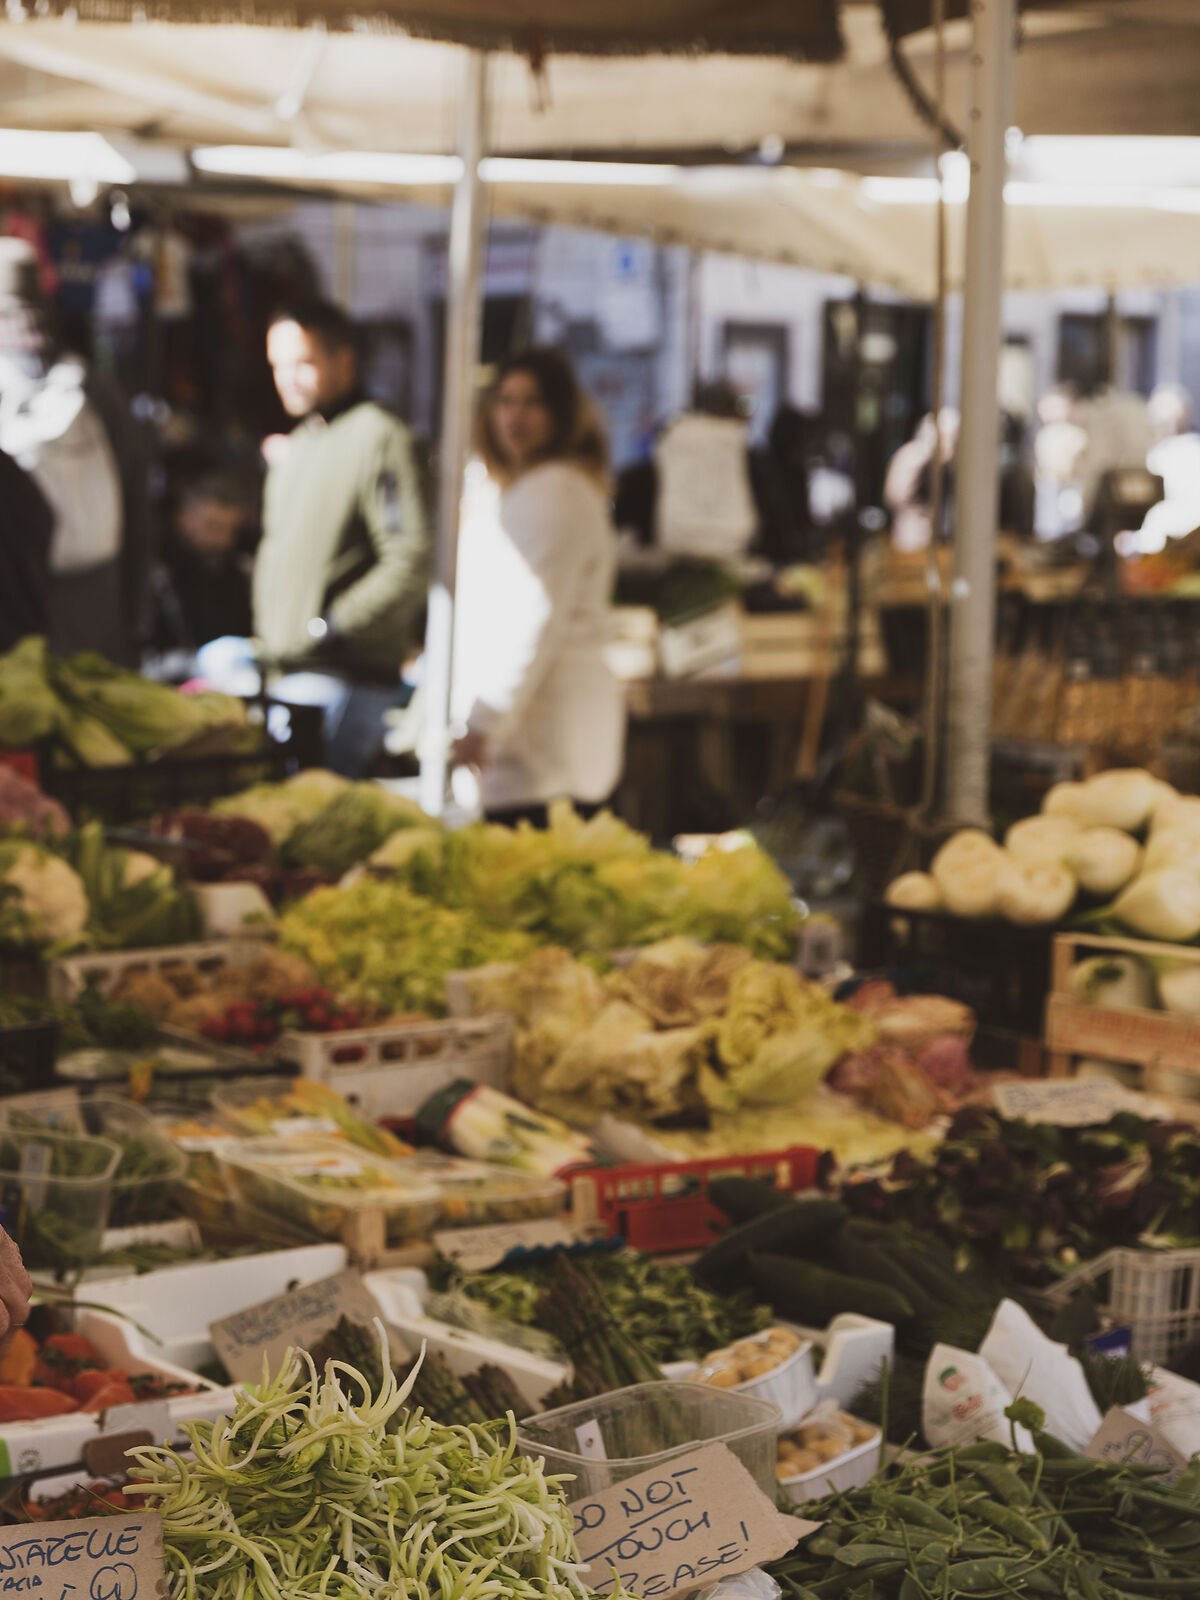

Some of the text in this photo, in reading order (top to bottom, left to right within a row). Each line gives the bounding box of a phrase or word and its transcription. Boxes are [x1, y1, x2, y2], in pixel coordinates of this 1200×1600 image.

[621, 1467, 698, 1517] NOT
[583, 1511, 710, 1567] TOUCH
[593, 1520, 749, 1600] PEASE!
